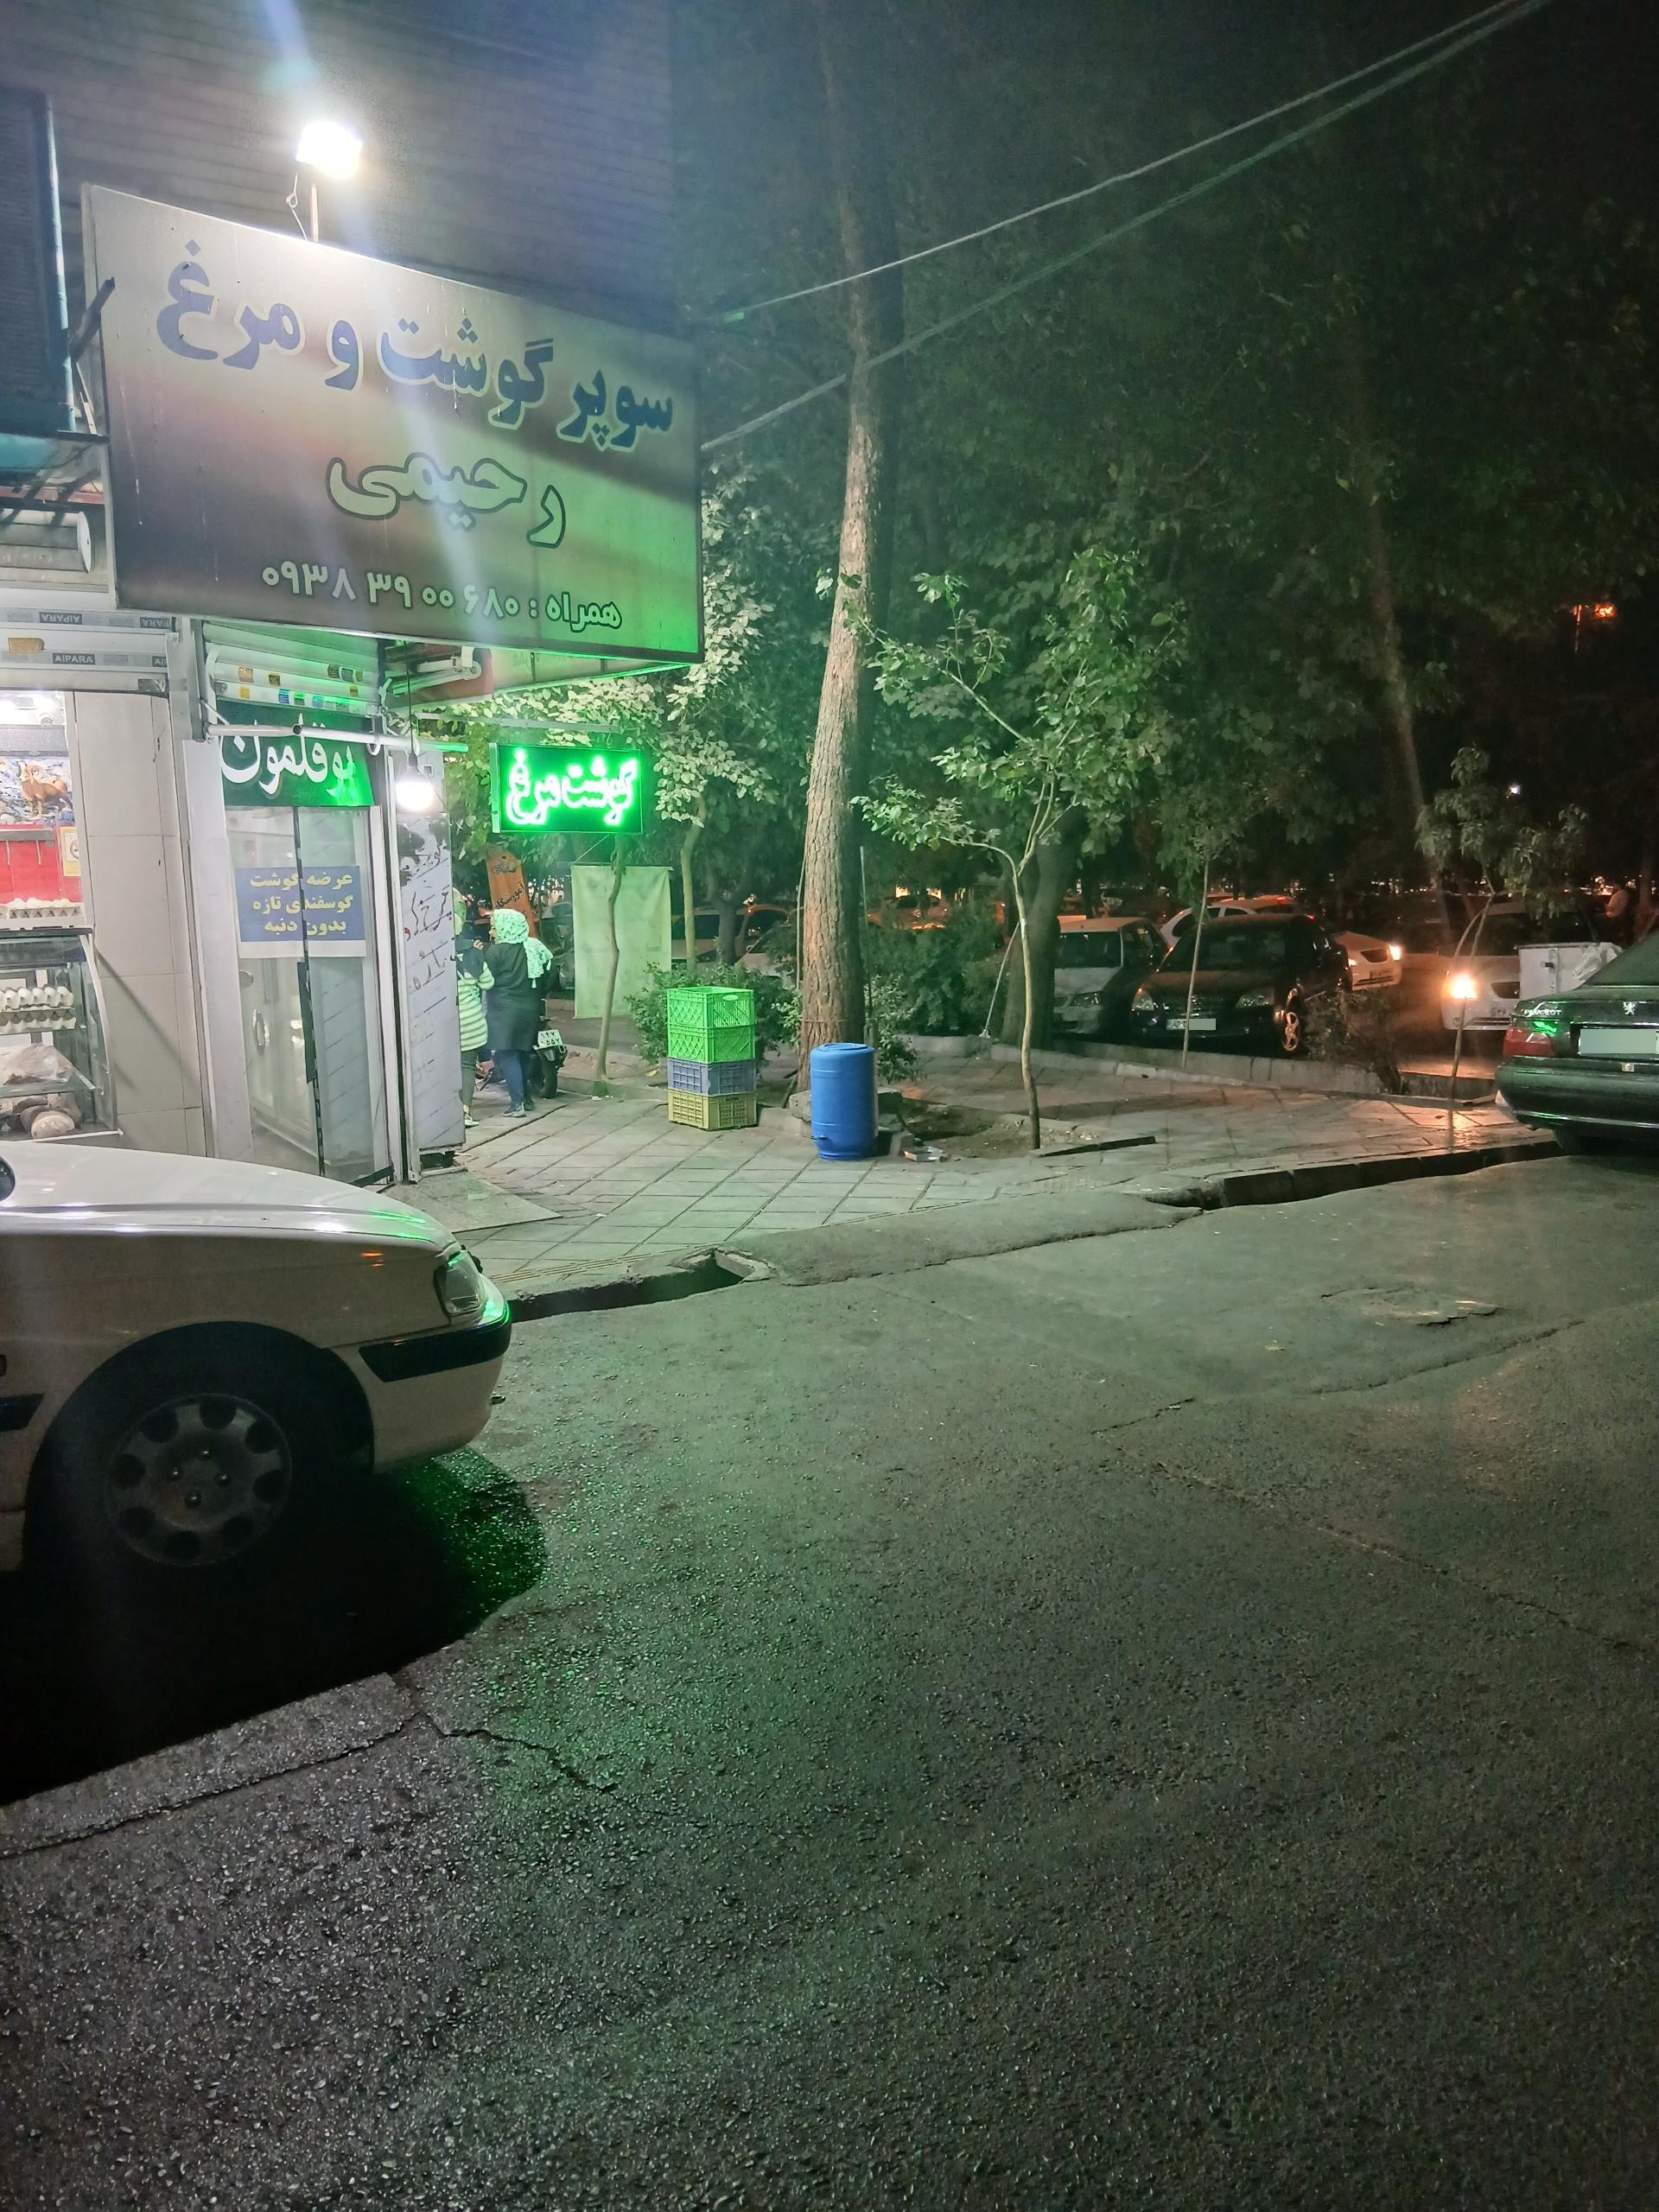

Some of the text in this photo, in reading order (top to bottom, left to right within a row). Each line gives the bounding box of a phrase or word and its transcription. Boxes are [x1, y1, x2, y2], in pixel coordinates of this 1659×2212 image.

[156, 239, 674, 452] سوپر گوشت و مرغ
[326, 451, 567, 550] رحیمی
[262, 560, 357, 601] ۰۹۳۸
[366, 572, 412, 608] ۳۹
[463, 583, 519, 620] ۶۸۰
[54, 654, 94, 664] AIPARA
[506, 749, 638, 825] گوشت مرغ
[250, 872, 353, 891] عرضه گوشت
[252, 894, 353, 914] گوسفندی تازه
[264, 918, 346, 936] بدون دنبه
[1523, 1008, 1562, 1017] PEUGEOT
